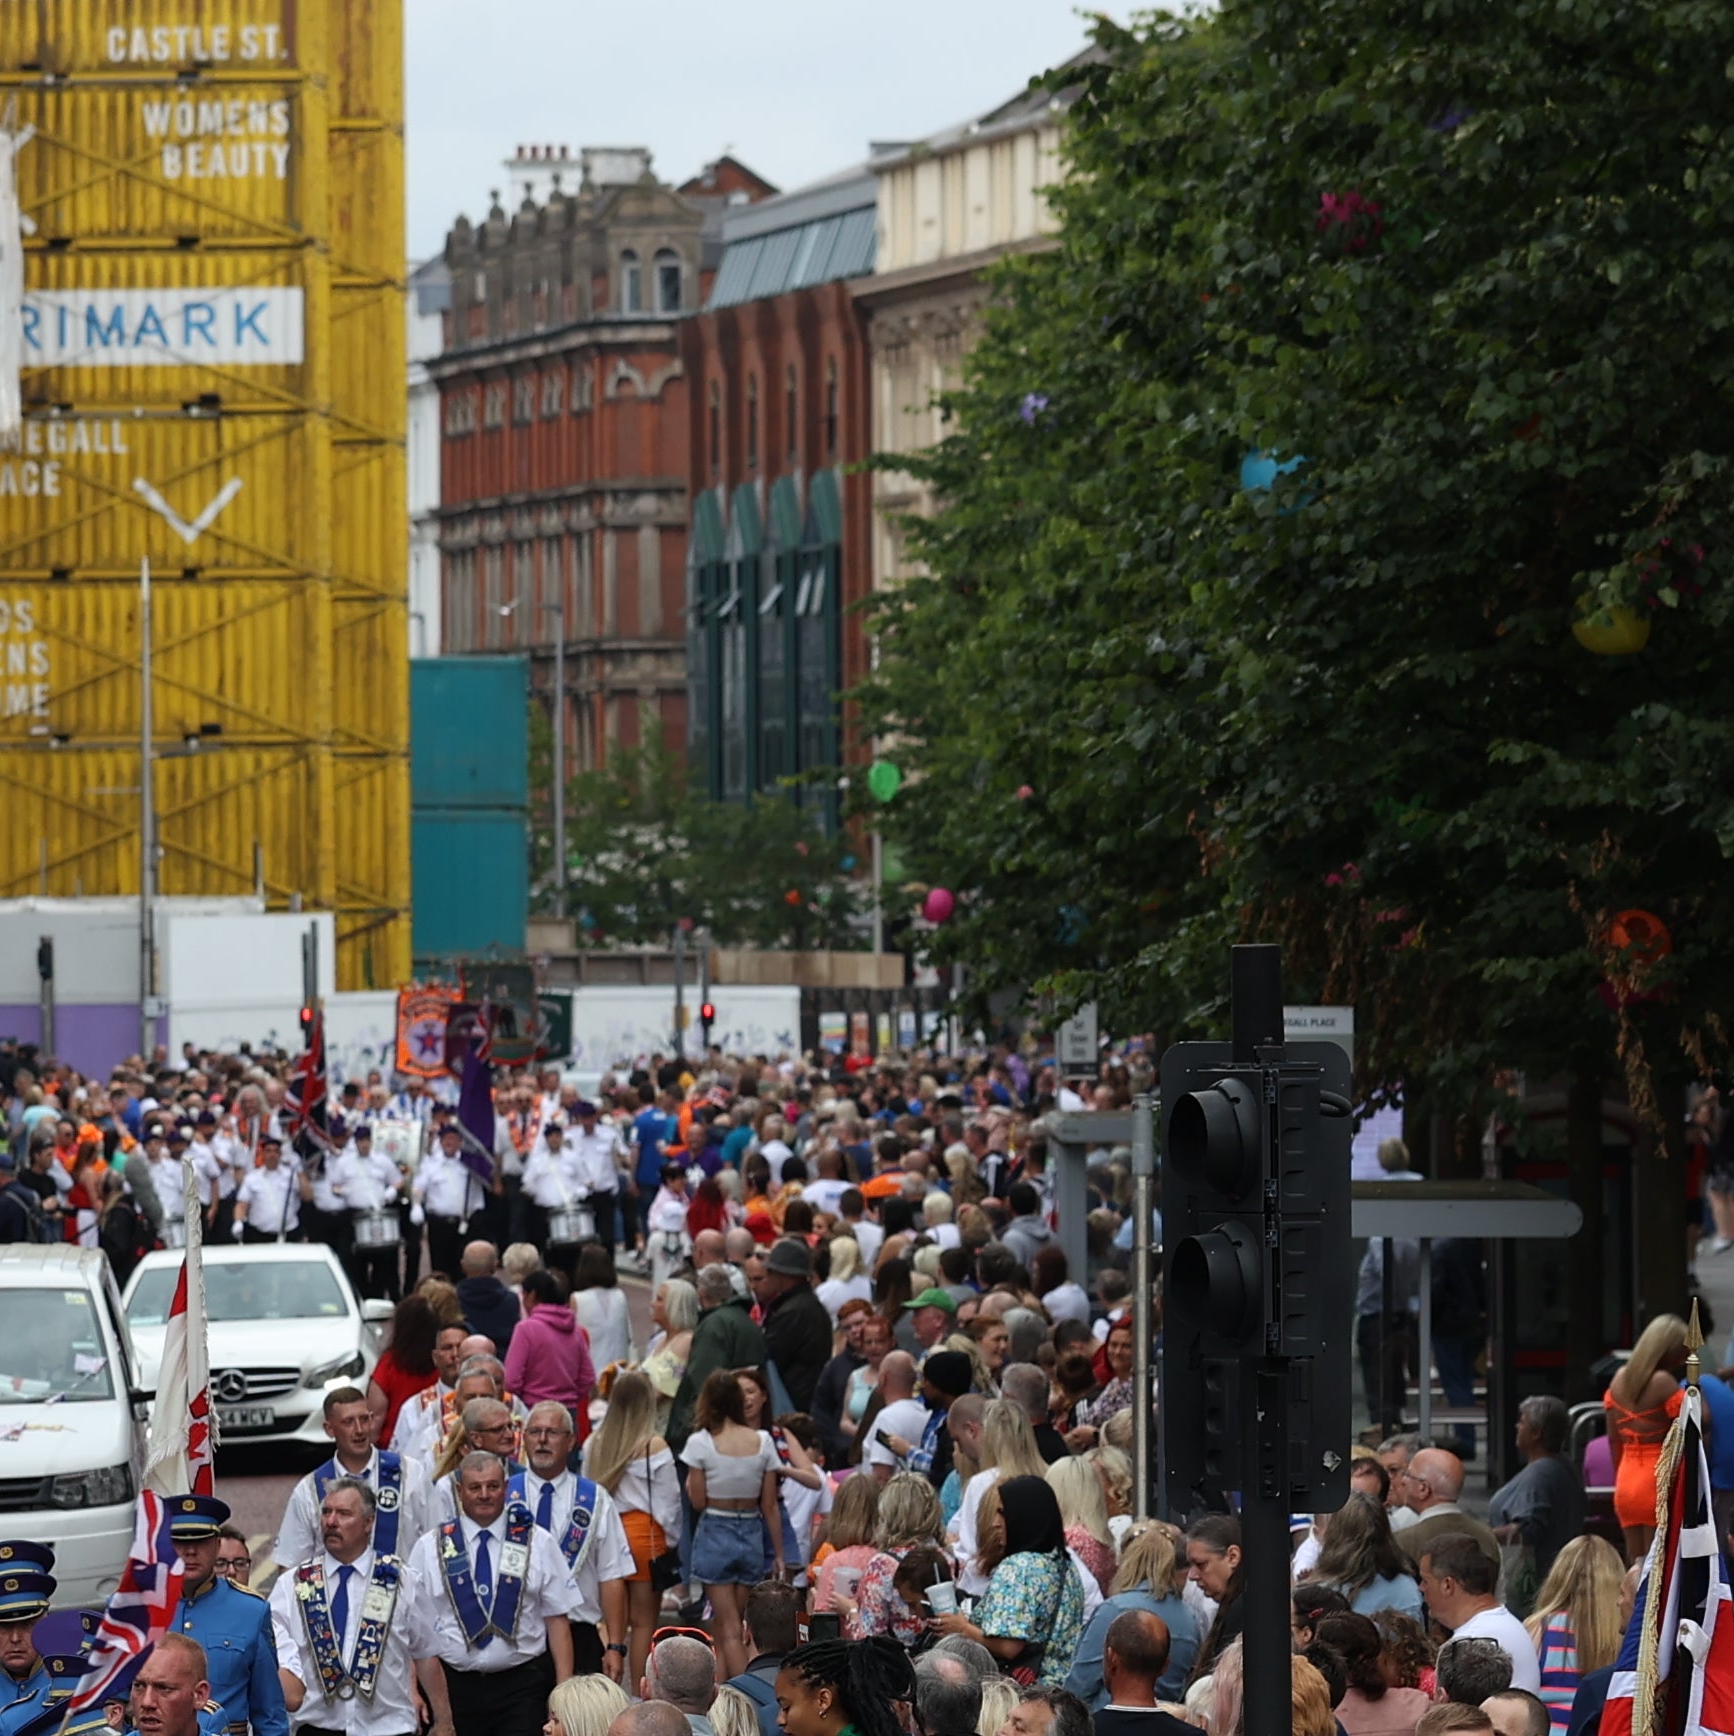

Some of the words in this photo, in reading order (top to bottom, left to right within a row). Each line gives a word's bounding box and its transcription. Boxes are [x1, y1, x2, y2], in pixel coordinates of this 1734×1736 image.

[107, 25, 230, 61] CASTLE
[239, 24, 290, 60] ST.
[142, 100, 291, 137] WOMENS
[161, 142, 292, 180] BEAUTY
[22, 300, 270, 349] RIMARK
[1283, 1018, 1308, 1028] EGALL
[1311, 1017, 1337, 1028] PLACE
